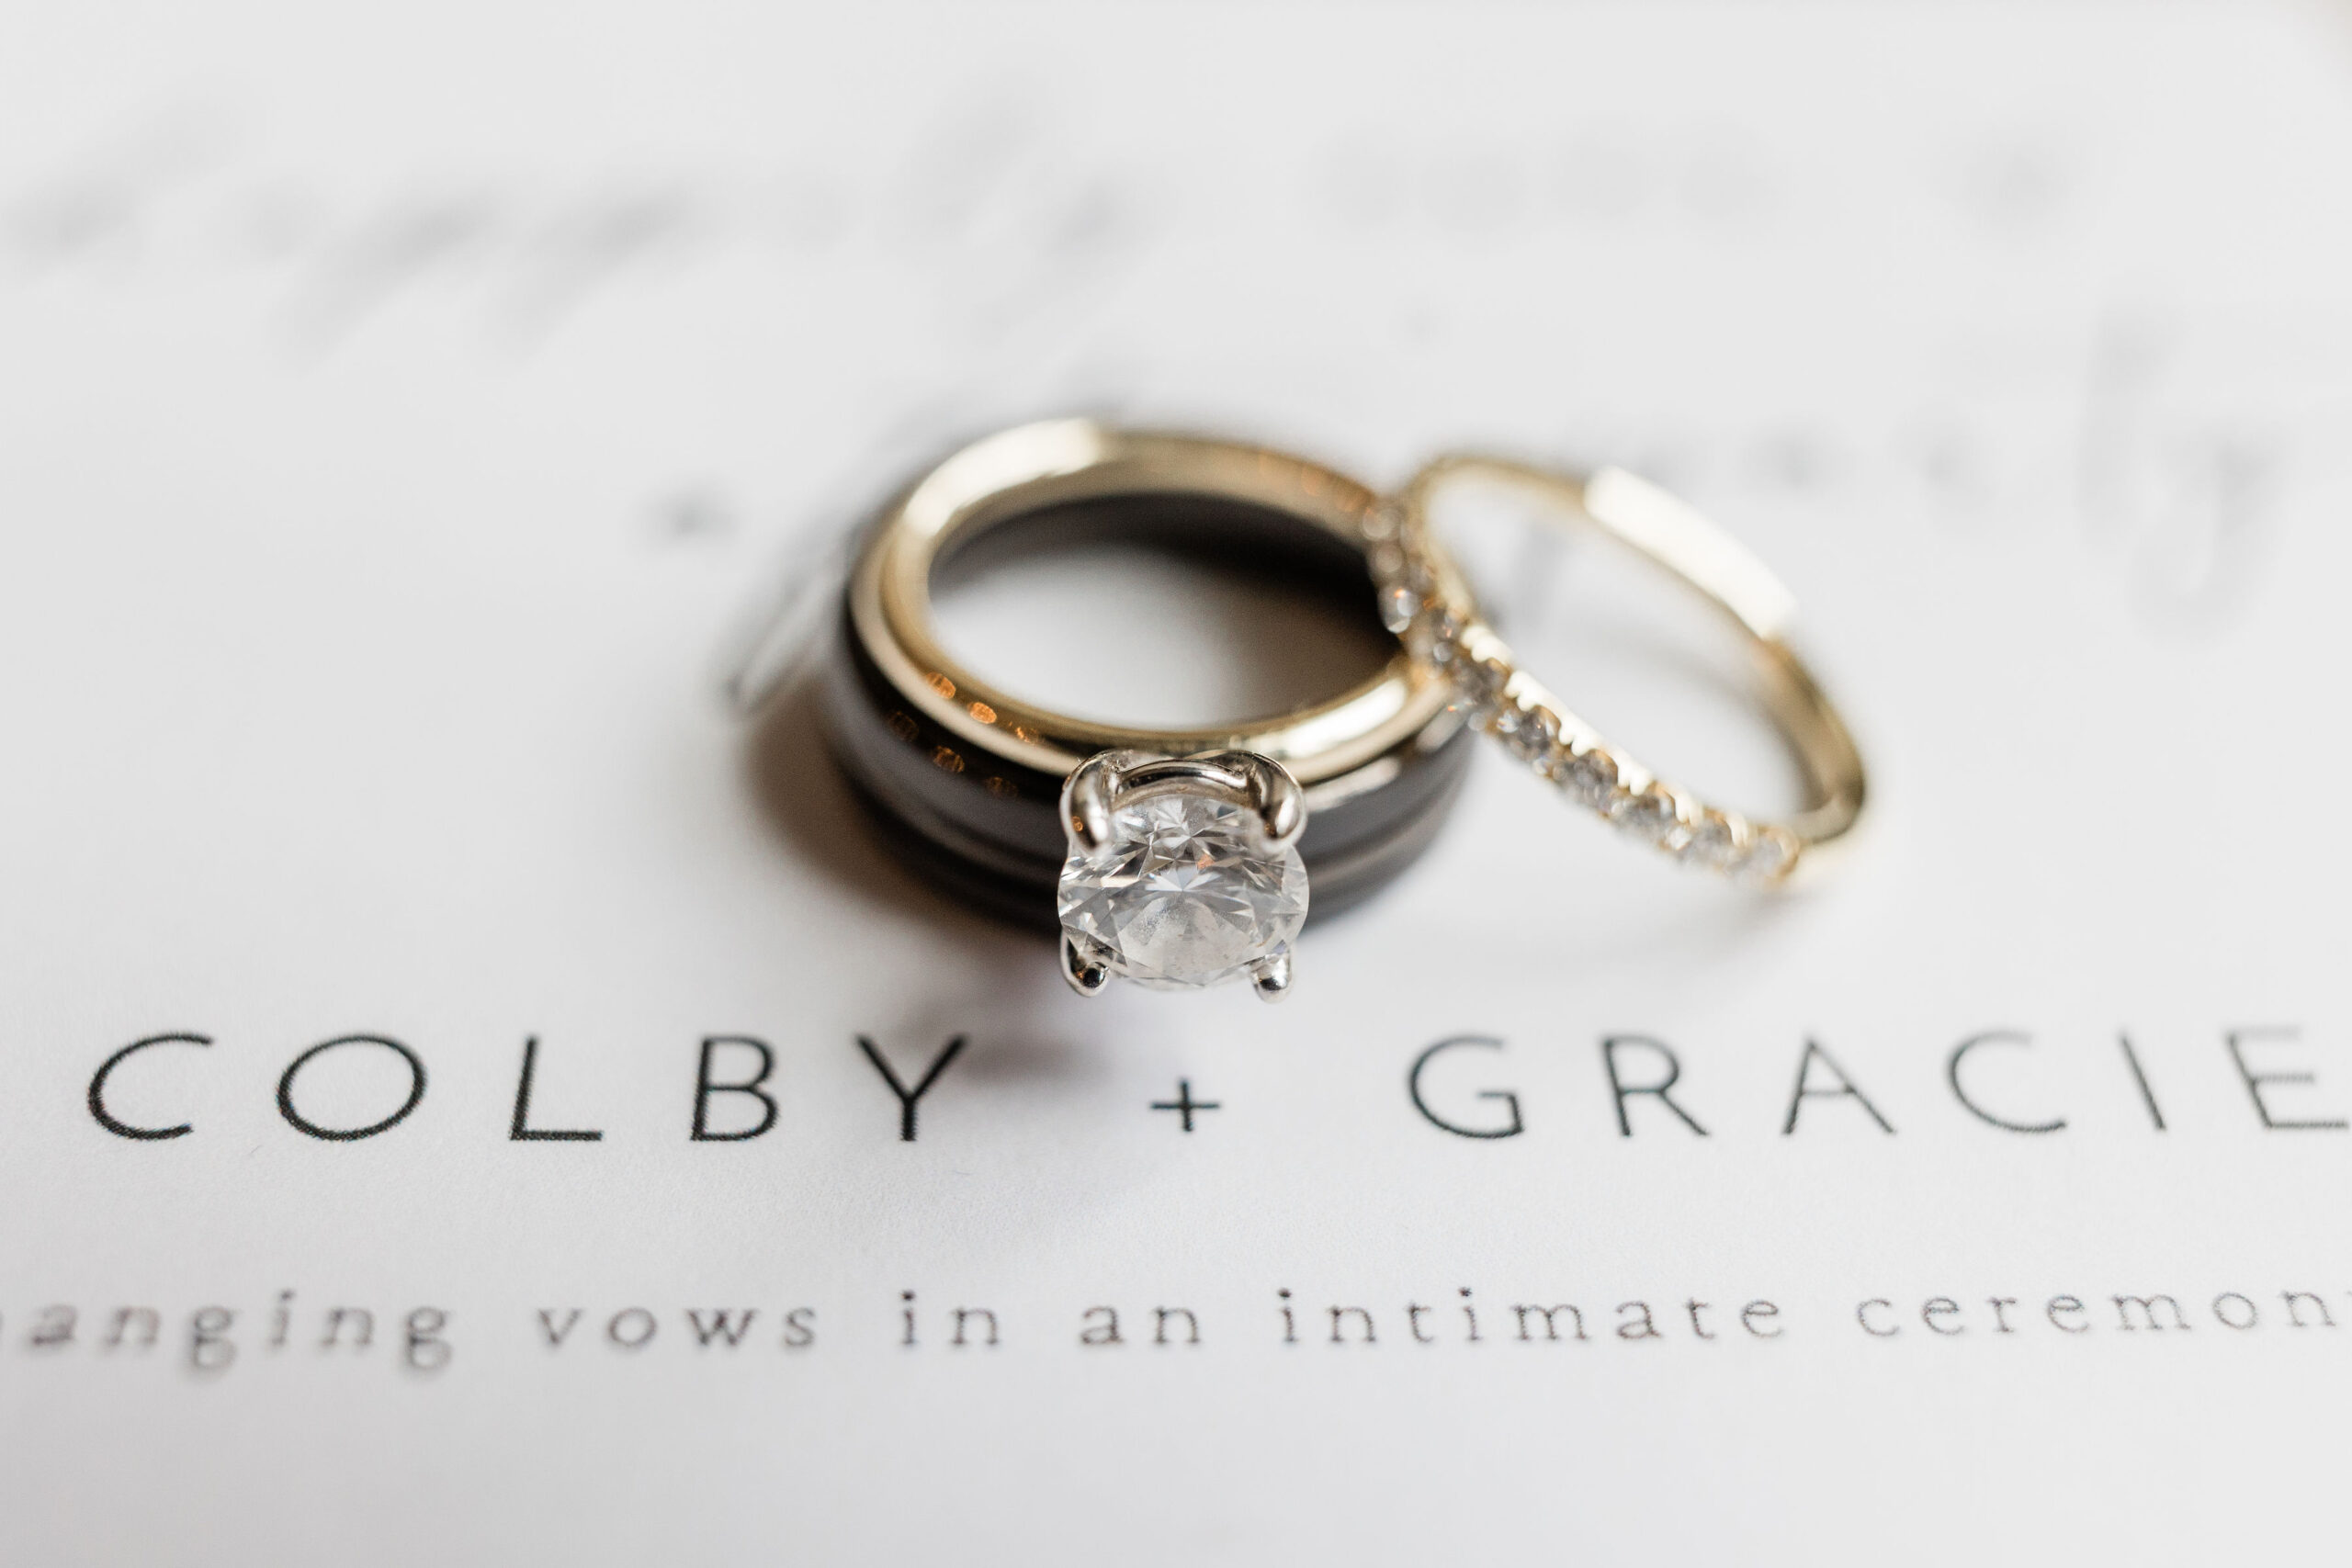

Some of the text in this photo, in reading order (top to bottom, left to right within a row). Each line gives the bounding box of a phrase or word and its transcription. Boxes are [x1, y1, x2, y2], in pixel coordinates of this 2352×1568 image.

[85, 1026, 2351, 1145] COLBY + GRACIE
[0, 1286, 2352, 1375] anging vows in an intimate ceremon
